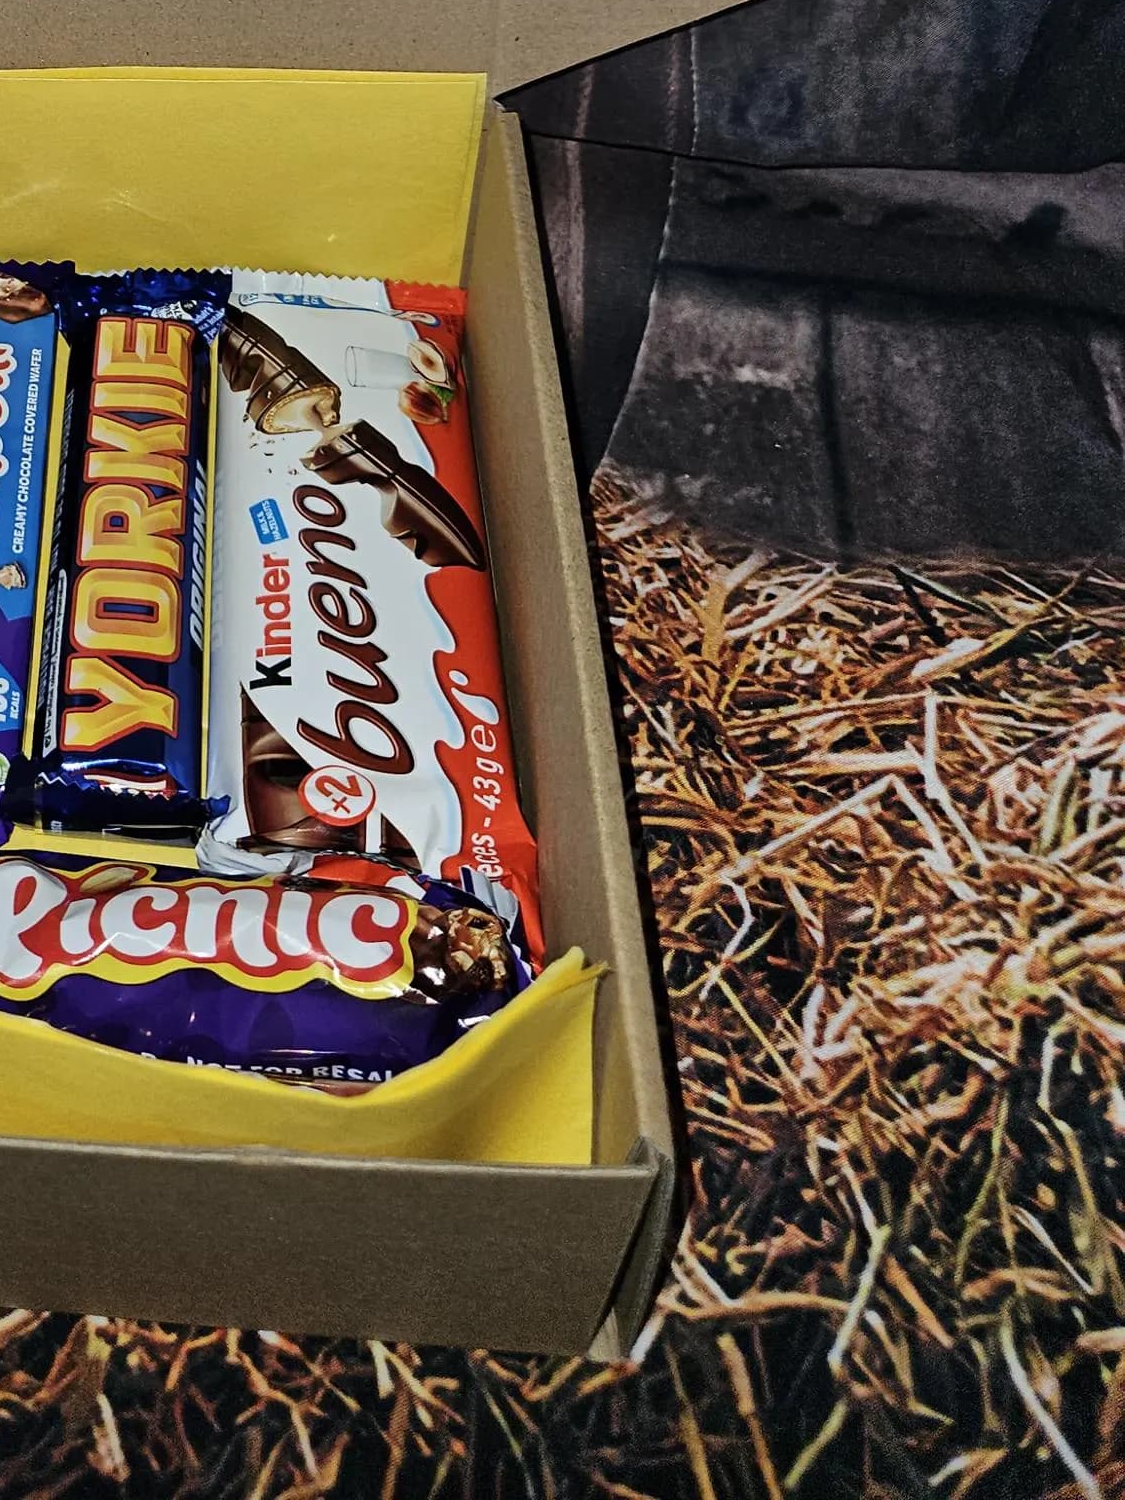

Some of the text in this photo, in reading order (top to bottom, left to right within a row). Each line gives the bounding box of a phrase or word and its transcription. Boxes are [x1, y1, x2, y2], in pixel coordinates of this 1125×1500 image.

[12, 347, 43, 554] CREAMY CHOCOLATE COVERED WAFER
[60, 314, 196, 754] YORKIE
[292, 485, 415, 776] bueno
[9, 690, 20, 720] KCALS
[472, 833, 504, 884] eces
[313, 1065, 393, 1083] RESAL
